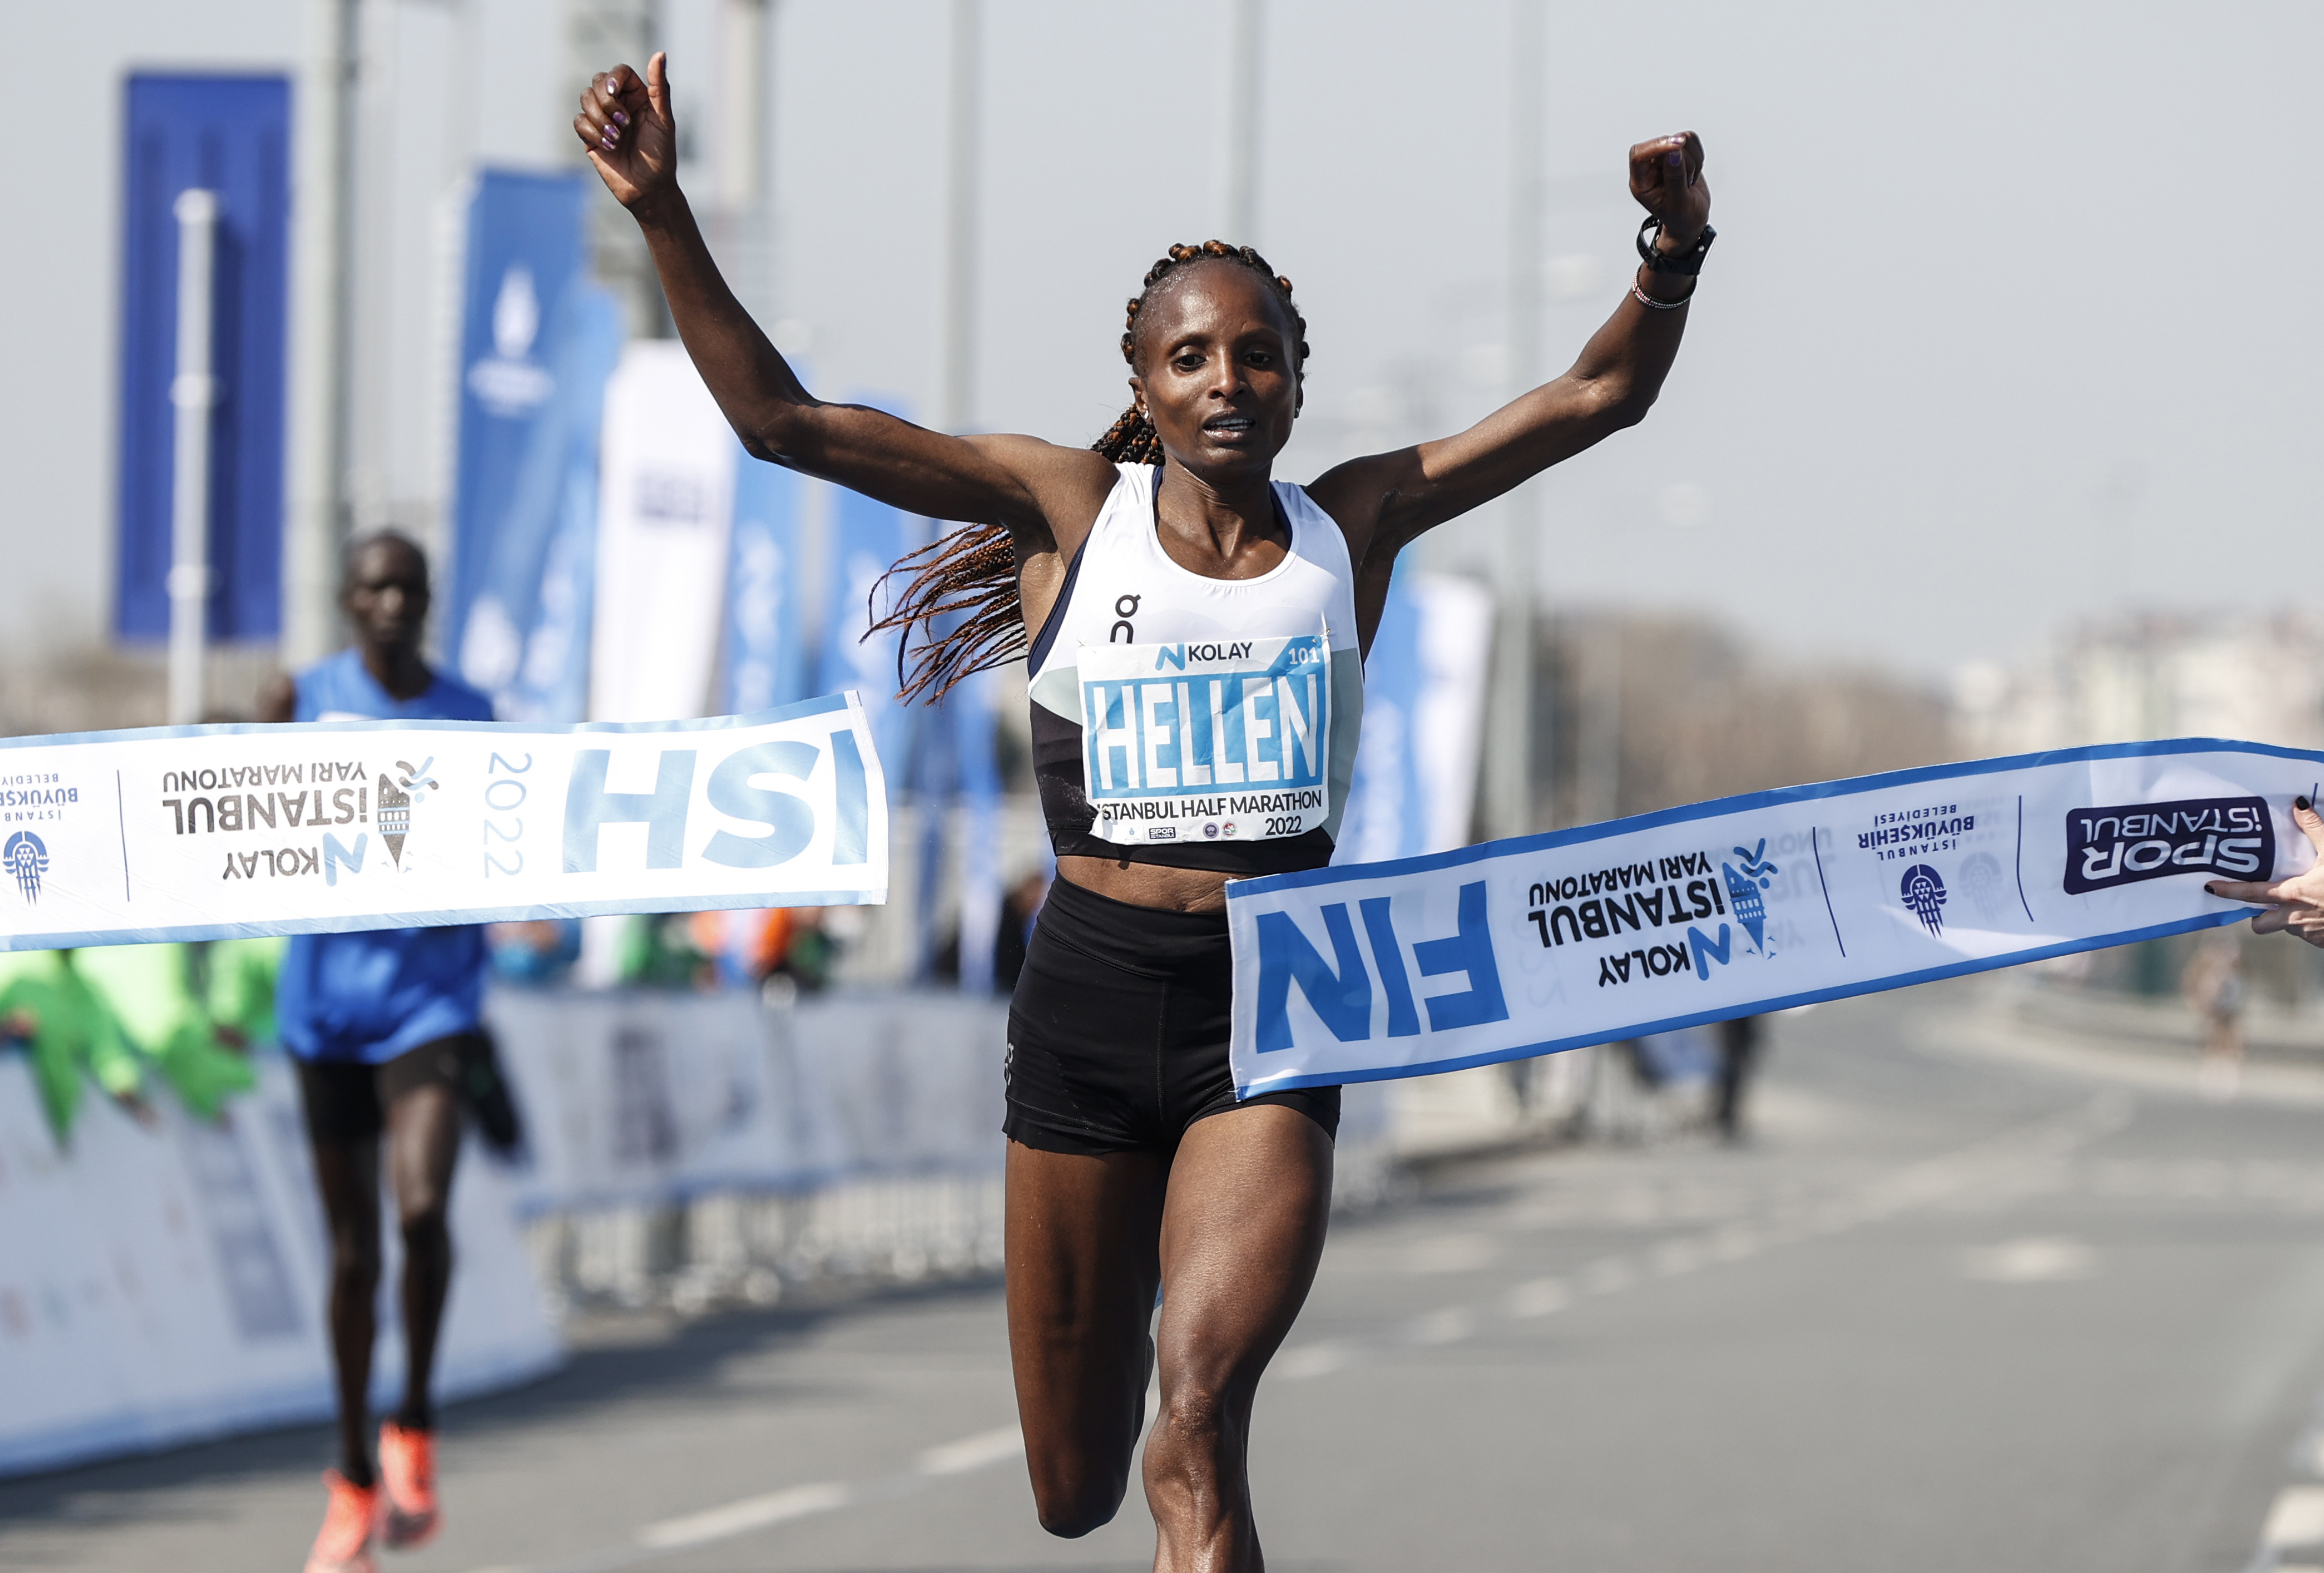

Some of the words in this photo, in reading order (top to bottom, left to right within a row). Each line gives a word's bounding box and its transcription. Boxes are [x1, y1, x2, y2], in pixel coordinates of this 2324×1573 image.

[1189, 642, 1252, 661] KOLAY
[1289, 647, 1321, 664] 101
[1093, 674, 1316, 790] HELLEN
[164, 764, 302, 792] MARATONU
[312, 762, 367, 782] YARI
[484, 752, 533, 878] 2022
[562, 729, 868, 874] ISH
[1182, 798, 1226, 817] HALF
[1231, 790, 1321, 814] MARATHON
[1875, 805, 1956, 825] BELEDİYESİ
[1265, 816, 1302, 835] 2022
[1858, 815, 1974, 849] BÜYÜKŞEHİR
[223, 847, 318, 880] KOLAY
[1877, 839, 1956, 860] İSTANBUL
[2082, 835, 2262, 880] SPOR
[1660, 852, 1712, 880] YARI
[1529, 861, 1655, 906] MARATONU
[1256, 881, 1509, 1053] FIN
[1599, 942, 1690, 987] KOLAY
